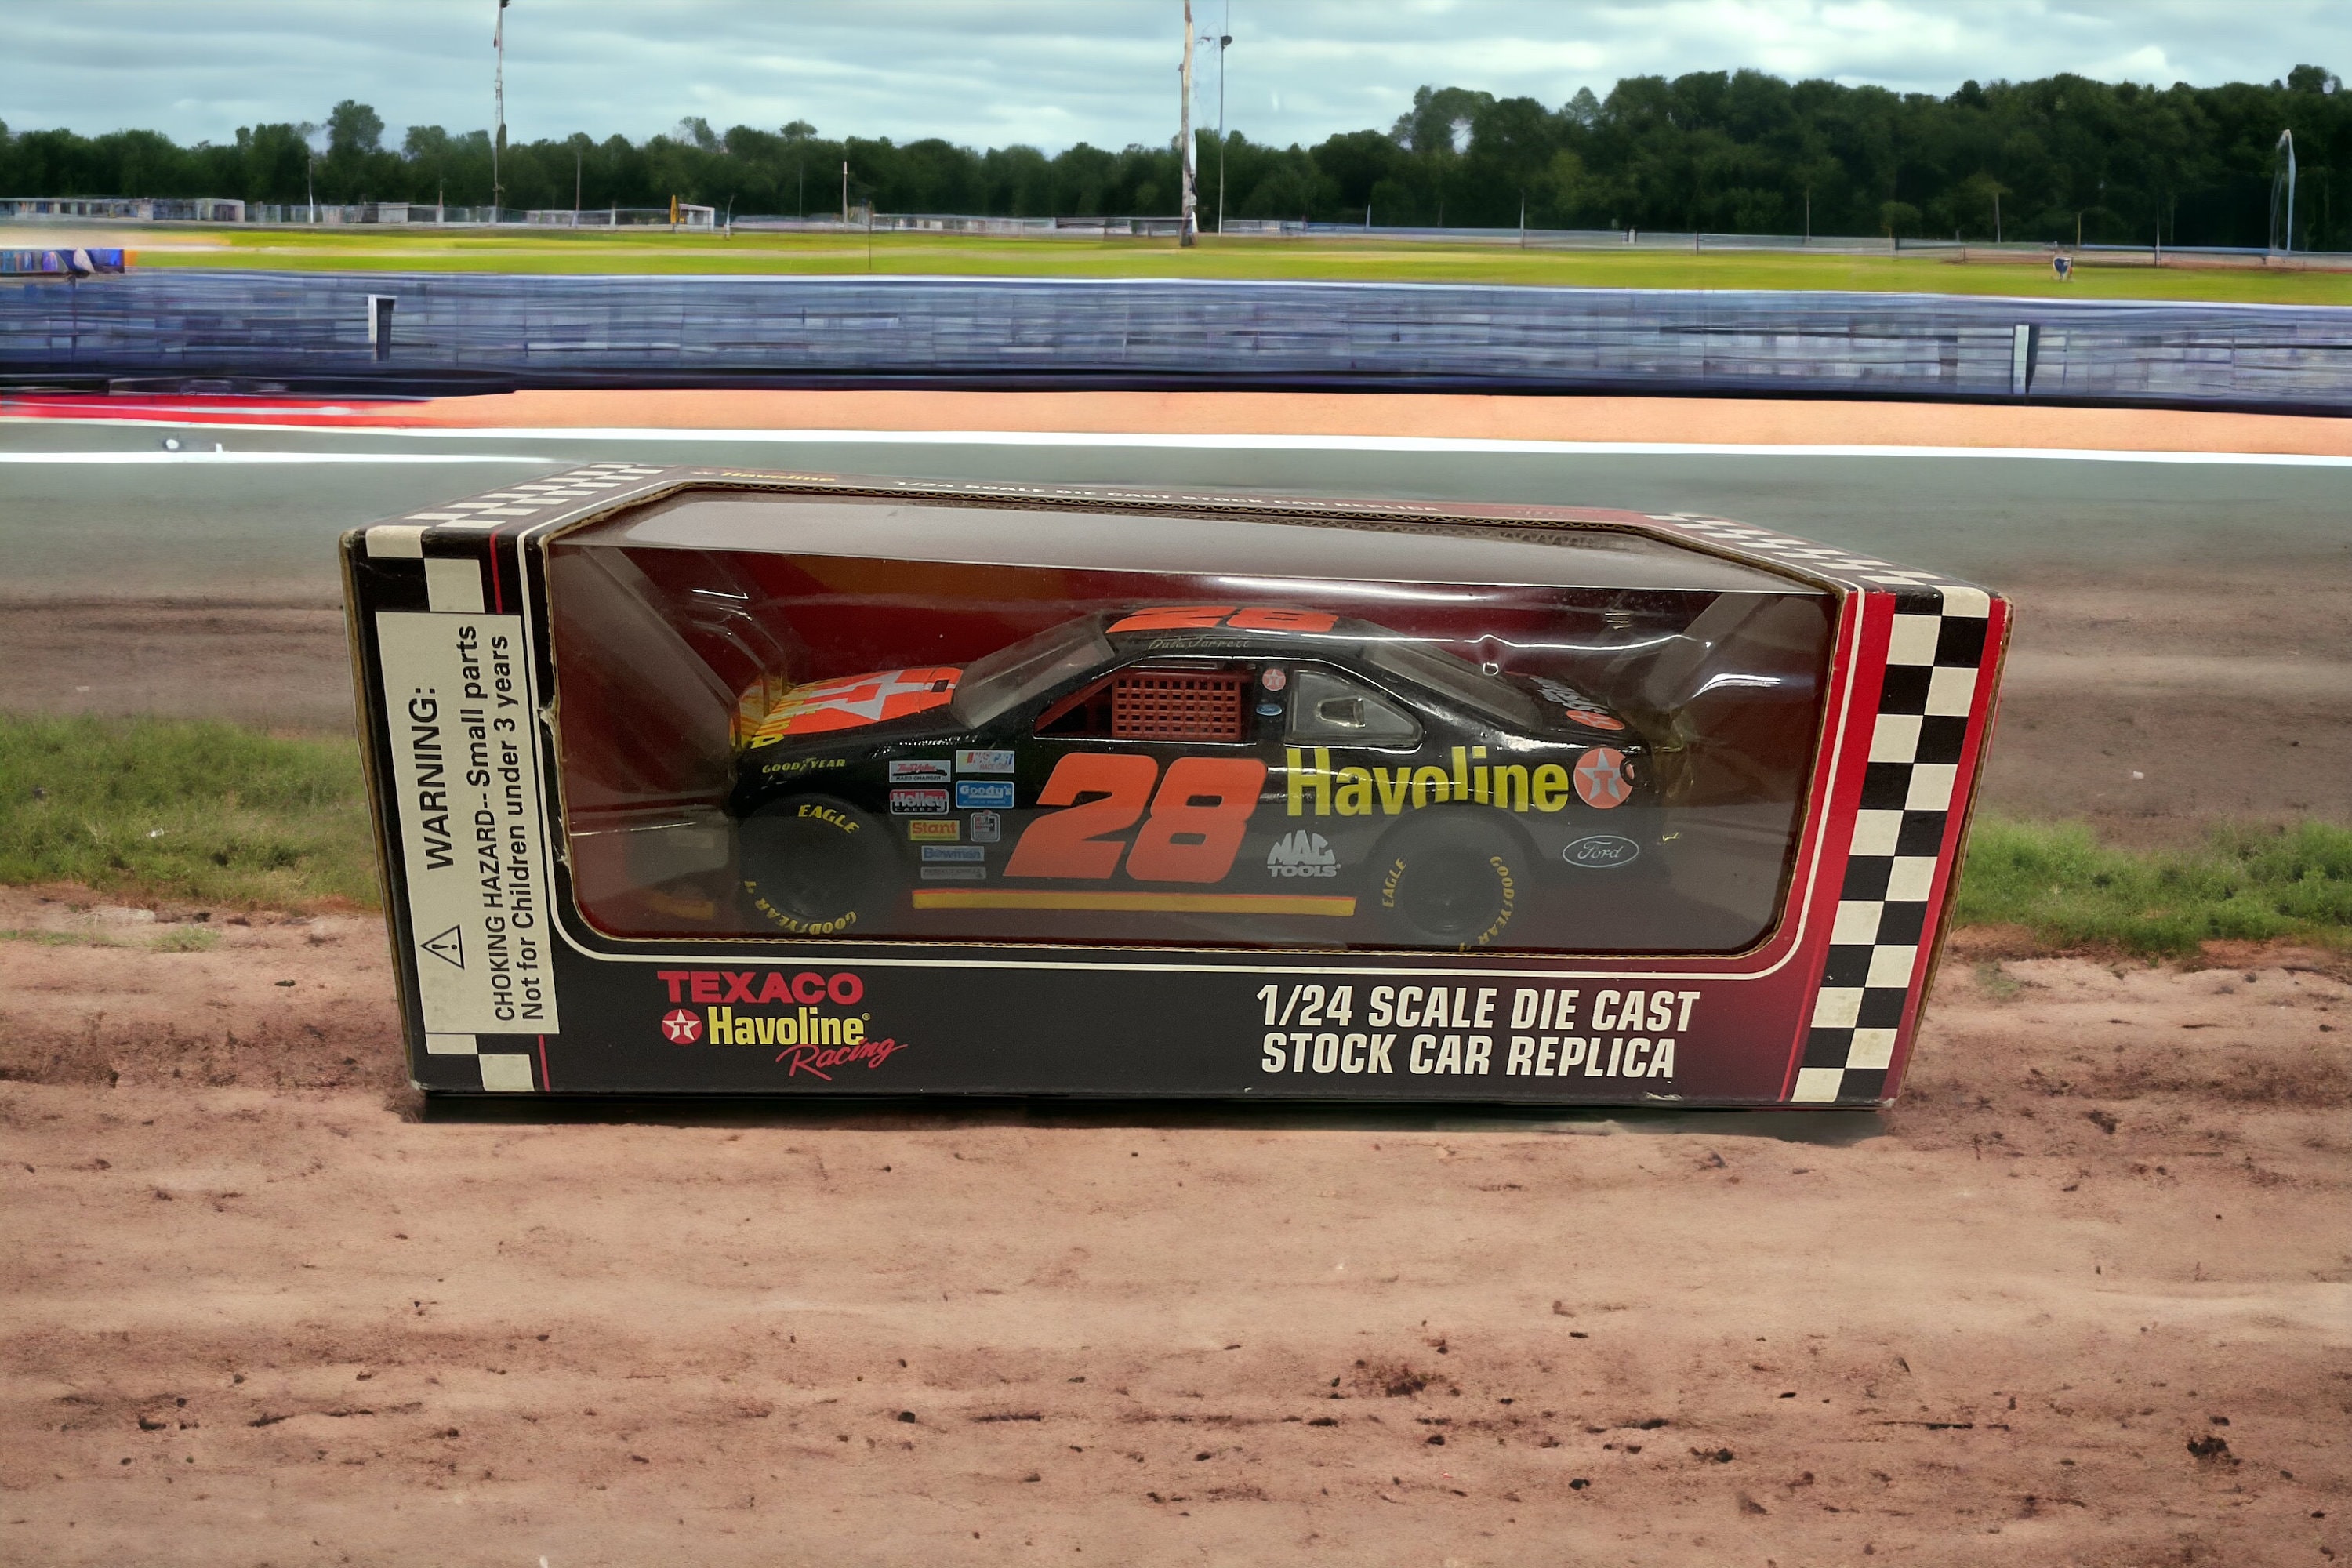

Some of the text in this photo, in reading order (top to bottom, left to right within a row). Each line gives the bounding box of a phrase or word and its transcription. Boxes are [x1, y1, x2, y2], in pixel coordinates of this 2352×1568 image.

[456, 625, 488, 699] parts
[460, 709, 491, 787] Small
[408, 688, 454, 871] WARNING:
[892, 791, 946, 812] Holley
[959, 785, 1012, 799] Goody's
[1285, 746, 1569, 817] Havoline
[491, 635, 544, 1020] Not for Children under 3 years
[797, 804, 860, 834] EAGLE
[912, 822, 956, 834] Stant
[1003, 752, 1268, 884] 28
[1267, 829, 1336, 866] MAC
[1577, 839, 1623, 860] Ford
[1267, 865, 1338, 878] TOOLS
[1381, 857, 1407, 908] EAGLE
[485, 916, 515, 1021] CHOKING
[656, 970, 865, 1005] TEXACO
[1256, 984, 1701, 1033] 1/24 SCALE DIE CAST
[775, 1037, 909, 1081] Racing
[1261, 1032, 1676, 1079] STOCK CAR REPLICA
